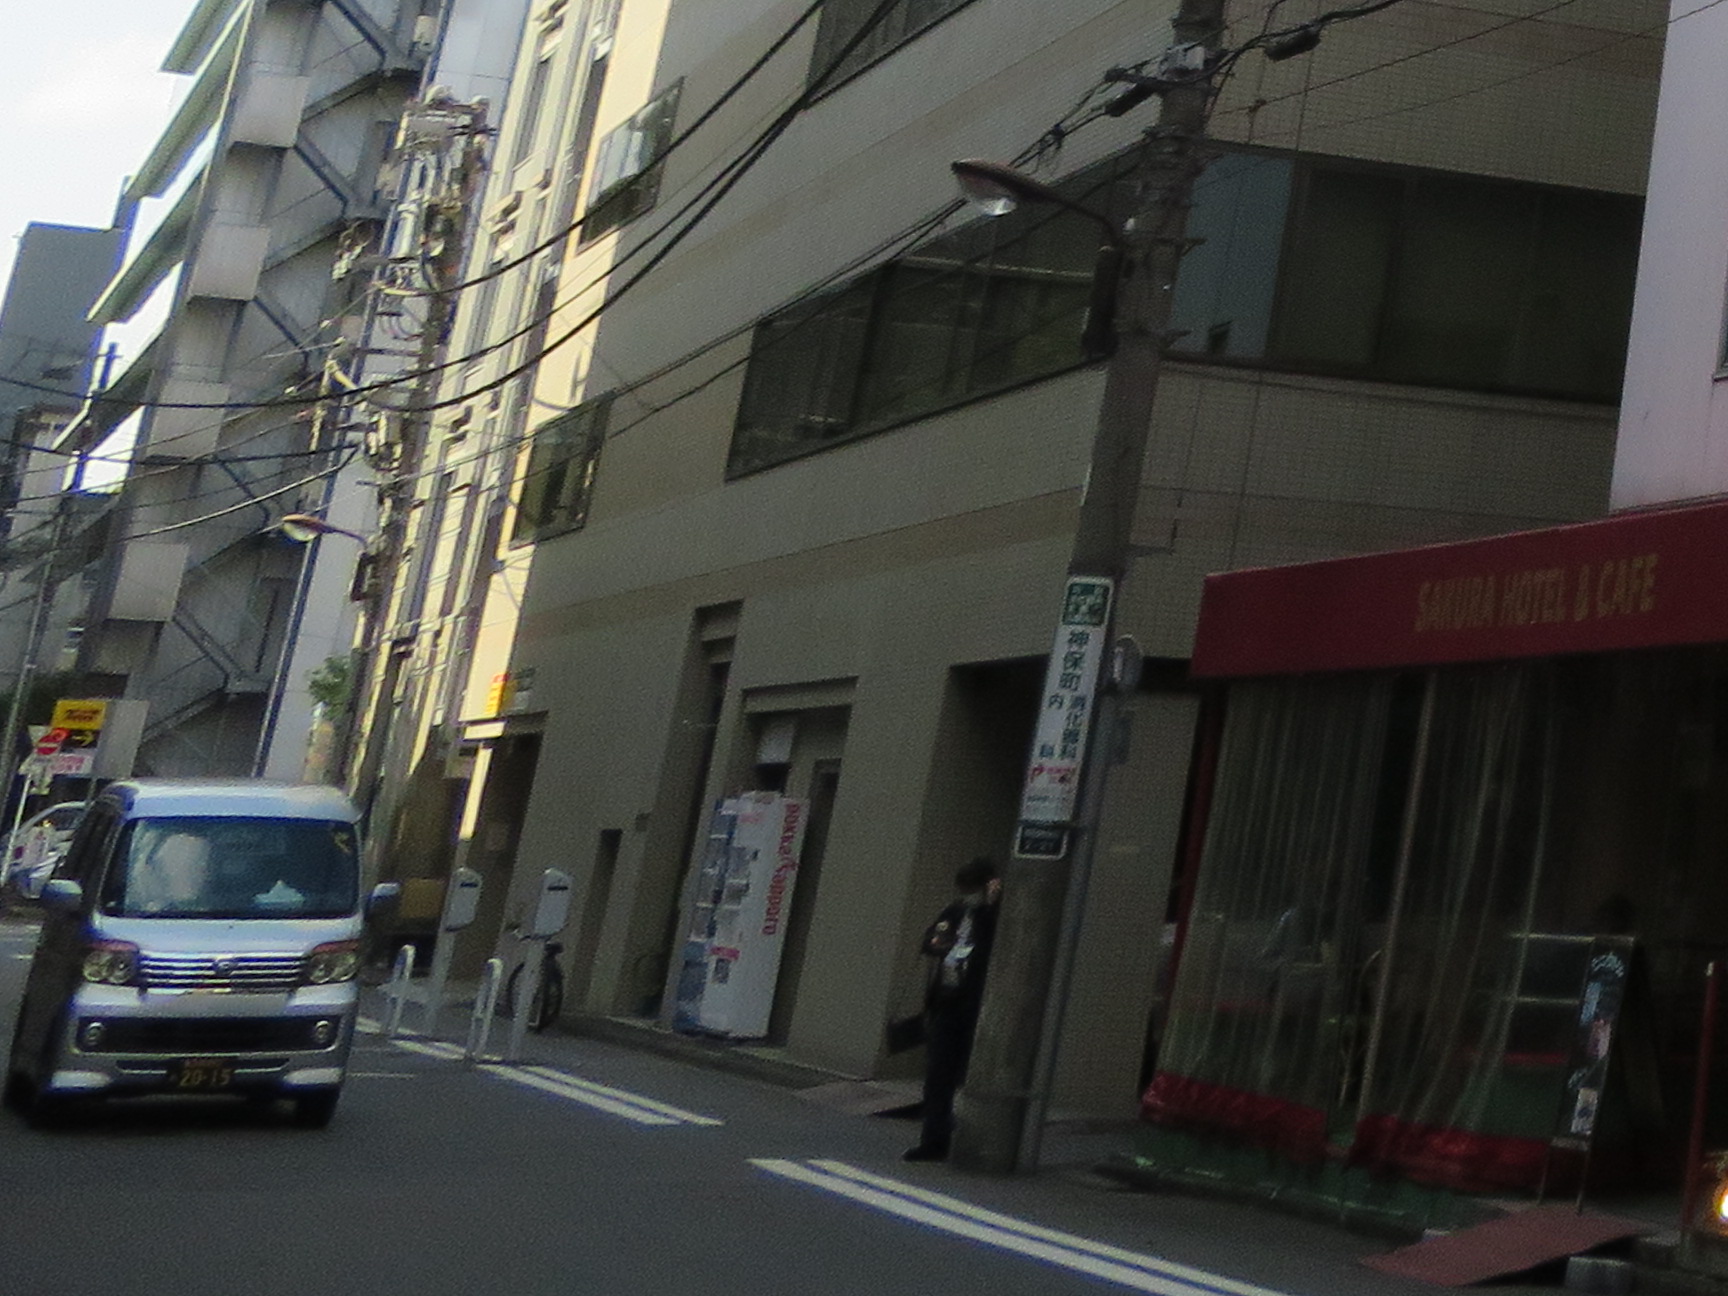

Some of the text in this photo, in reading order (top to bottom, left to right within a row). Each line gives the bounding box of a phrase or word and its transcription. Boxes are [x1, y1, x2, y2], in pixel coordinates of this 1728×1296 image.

[1413, 574, 1496, 634] SAKURA
[1498, 567, 1566, 628] HOTEL
[1597, 552, 1660, 618] CAFE
